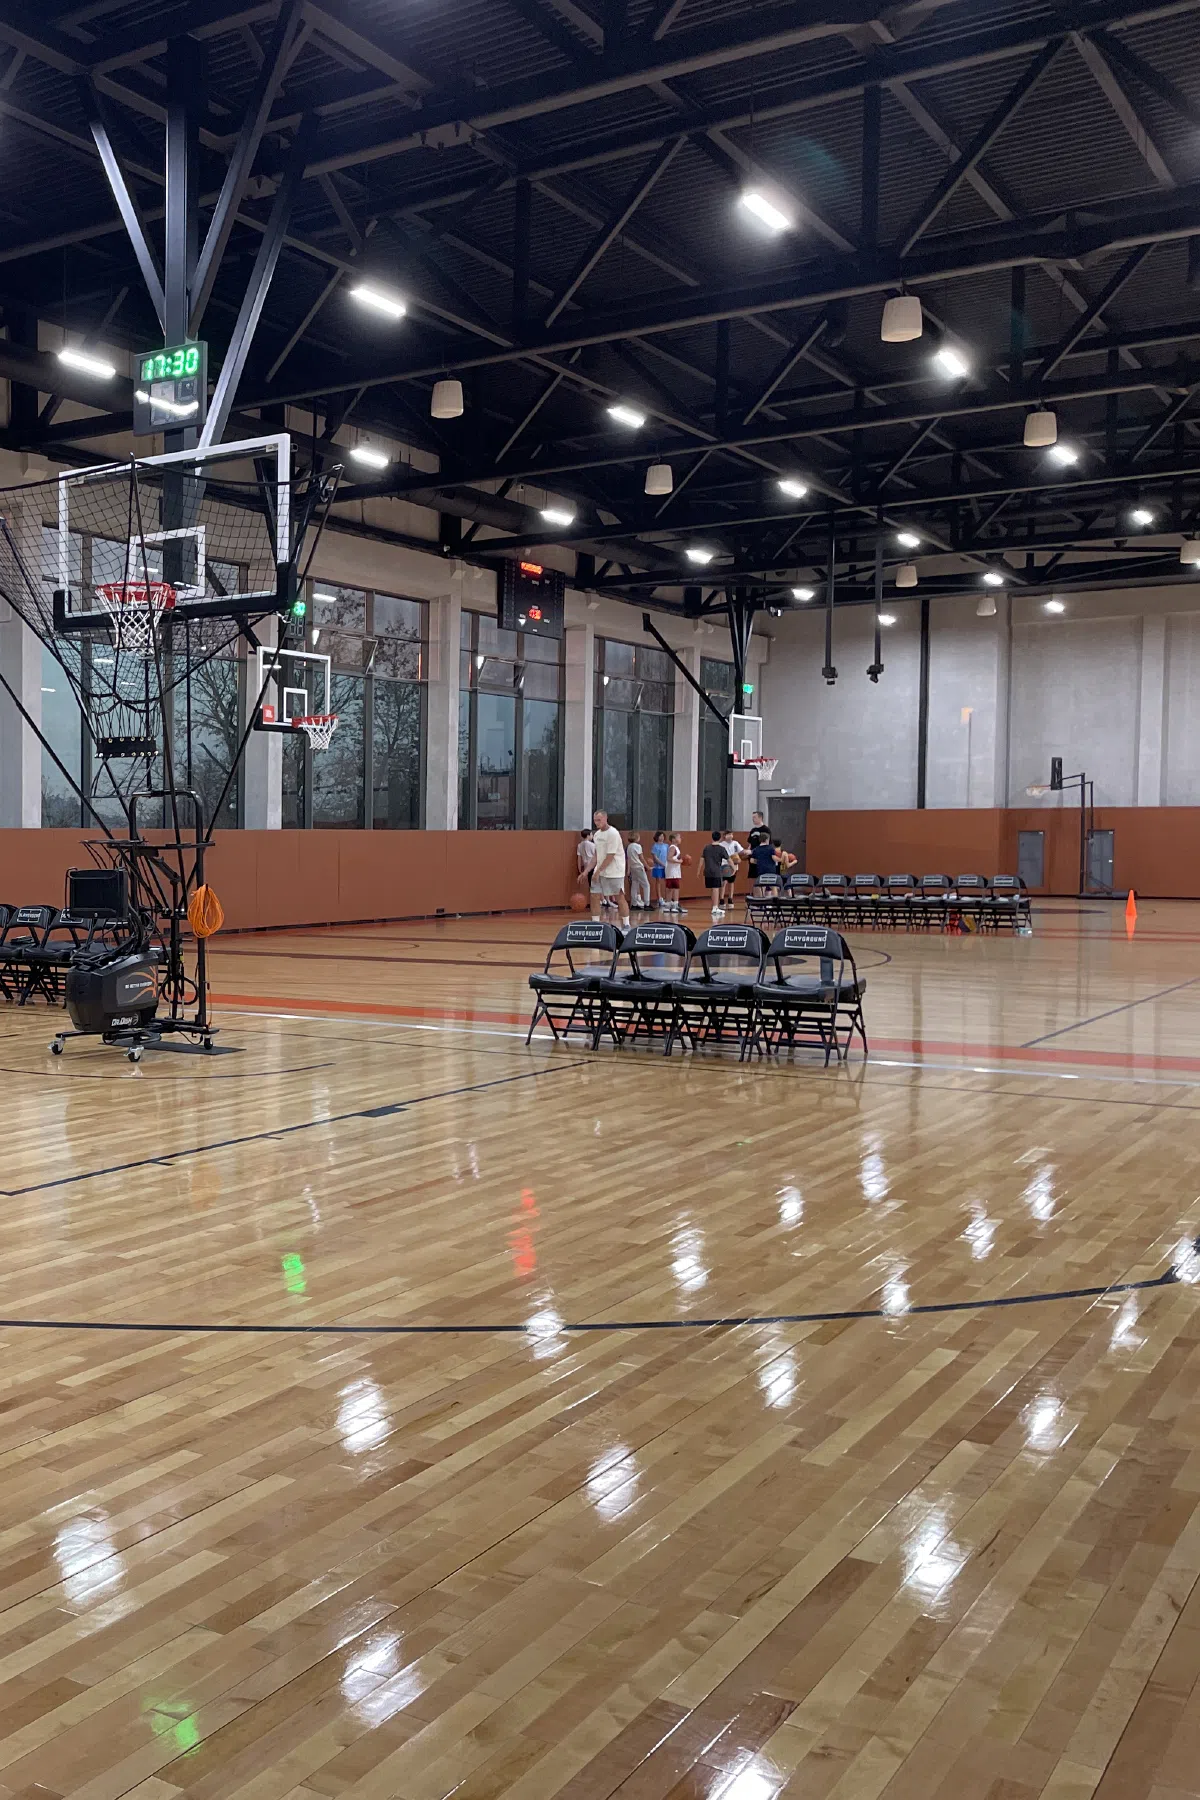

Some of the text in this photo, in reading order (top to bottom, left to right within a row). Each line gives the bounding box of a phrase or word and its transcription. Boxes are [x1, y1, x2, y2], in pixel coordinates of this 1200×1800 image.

[144, 348, 199, 380] 17:30
[635, 932, 675, 940] PLAYGROUND
[785, 935, 828, 943] PLAYGROUND
